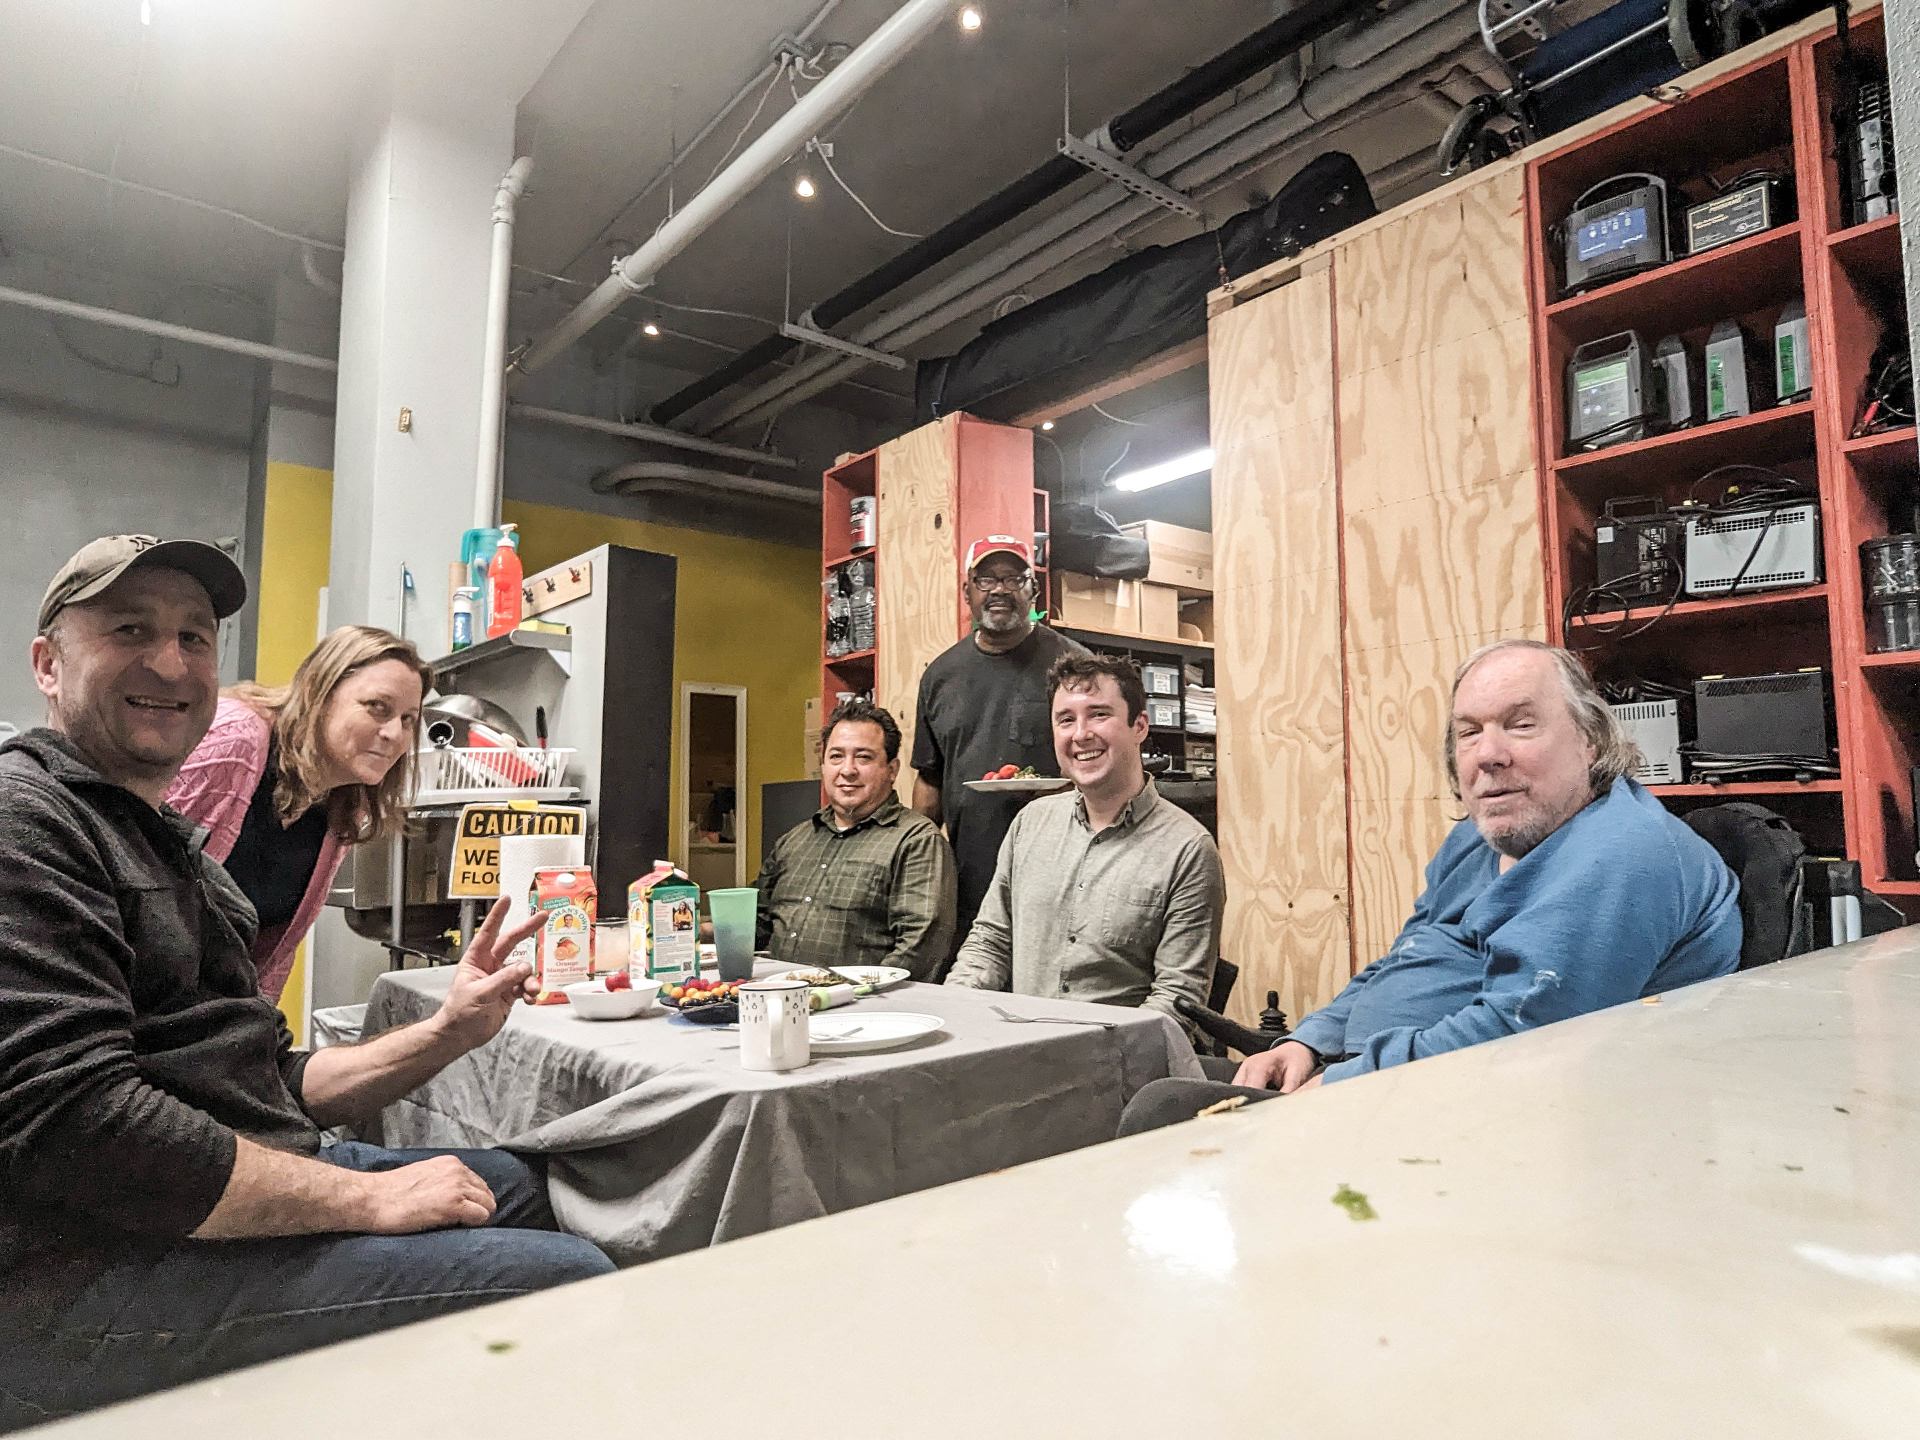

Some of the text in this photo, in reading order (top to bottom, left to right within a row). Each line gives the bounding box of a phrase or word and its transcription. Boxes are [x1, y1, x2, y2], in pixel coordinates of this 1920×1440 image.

[469, 813, 574, 835] CAUTION
[464, 849, 499, 866] WE
[461, 871, 500, 884] FLO
